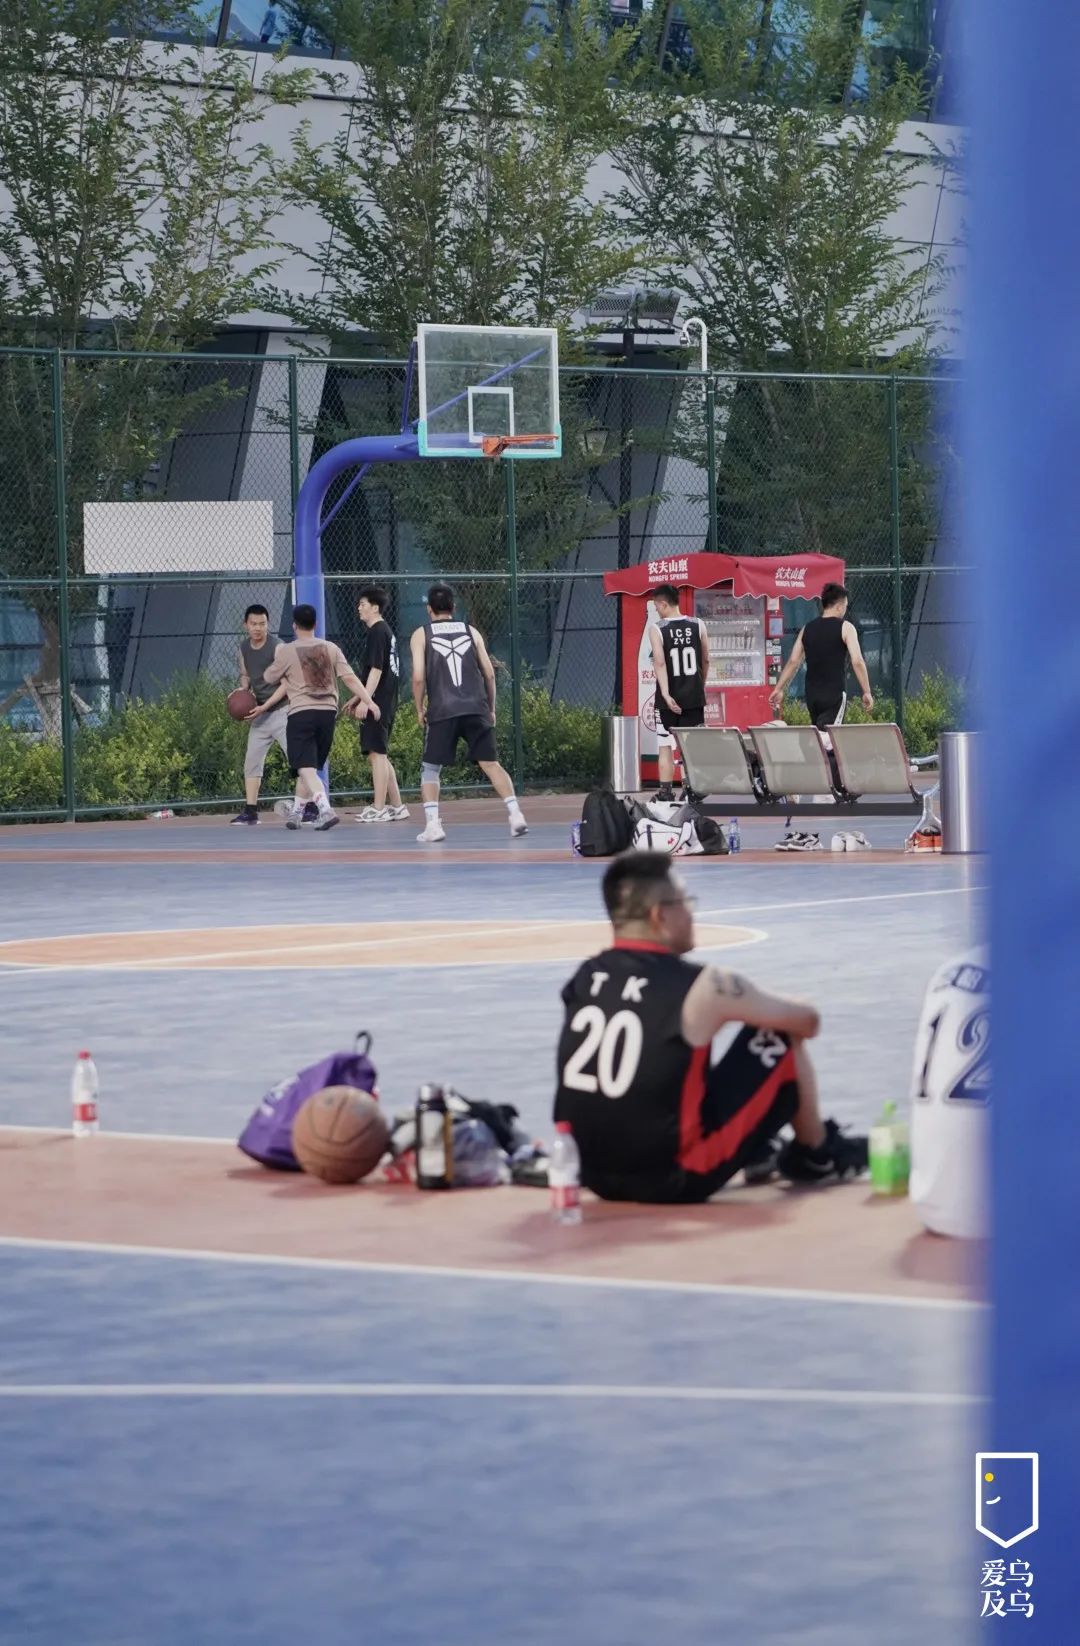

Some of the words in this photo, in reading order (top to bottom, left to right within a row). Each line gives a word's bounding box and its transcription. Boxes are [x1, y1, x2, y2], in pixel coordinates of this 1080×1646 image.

[648, 558, 688, 574] 农夫山泉
[775, 567, 807, 580] 农夫山泉
[669, 627, 692, 638] ICS
[674, 637, 691, 645] ZYC
[669, 646, 697, 677] 10
[563, 1004, 643, 1099] 20
[915, 1003, 990, 1108] 12
